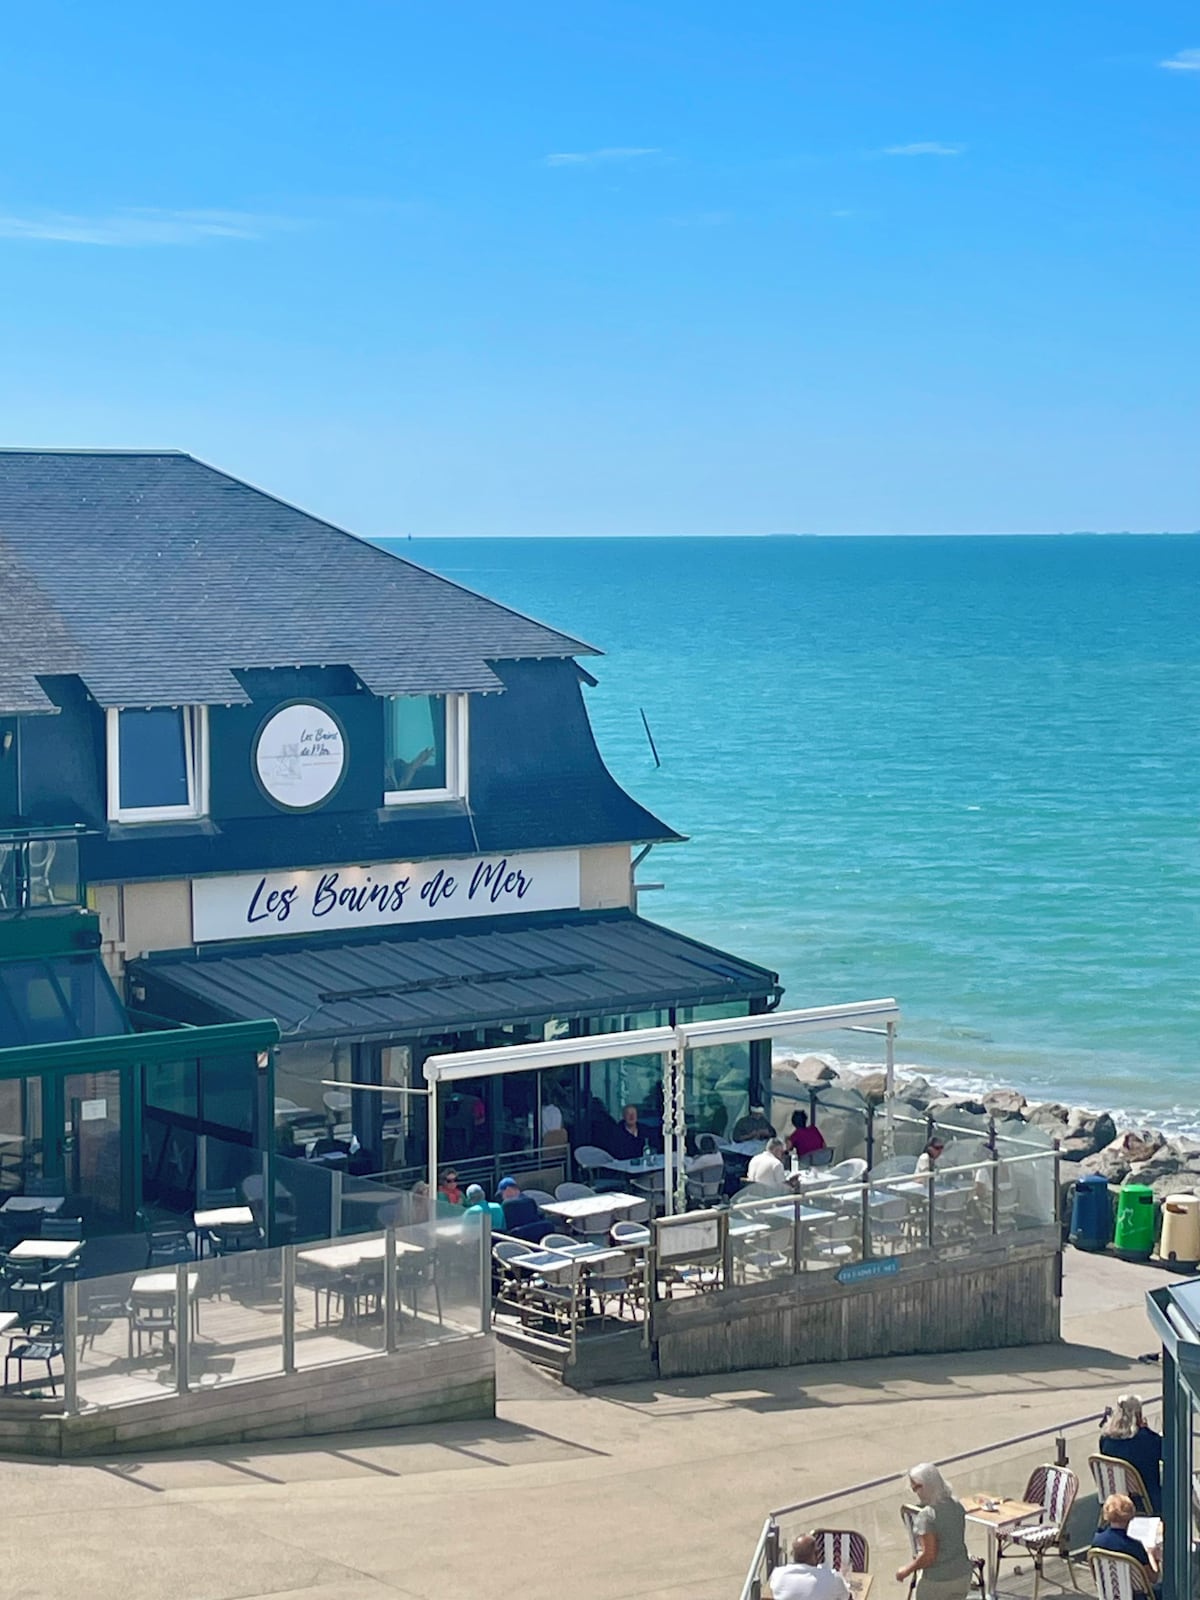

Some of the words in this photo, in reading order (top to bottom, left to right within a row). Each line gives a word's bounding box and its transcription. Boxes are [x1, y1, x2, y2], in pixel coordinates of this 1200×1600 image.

[246, 877, 299, 923] Les
[311, 872, 411, 917] Bains
[420, 868, 459, 908] de
[467, 858, 534, 904] Mer
